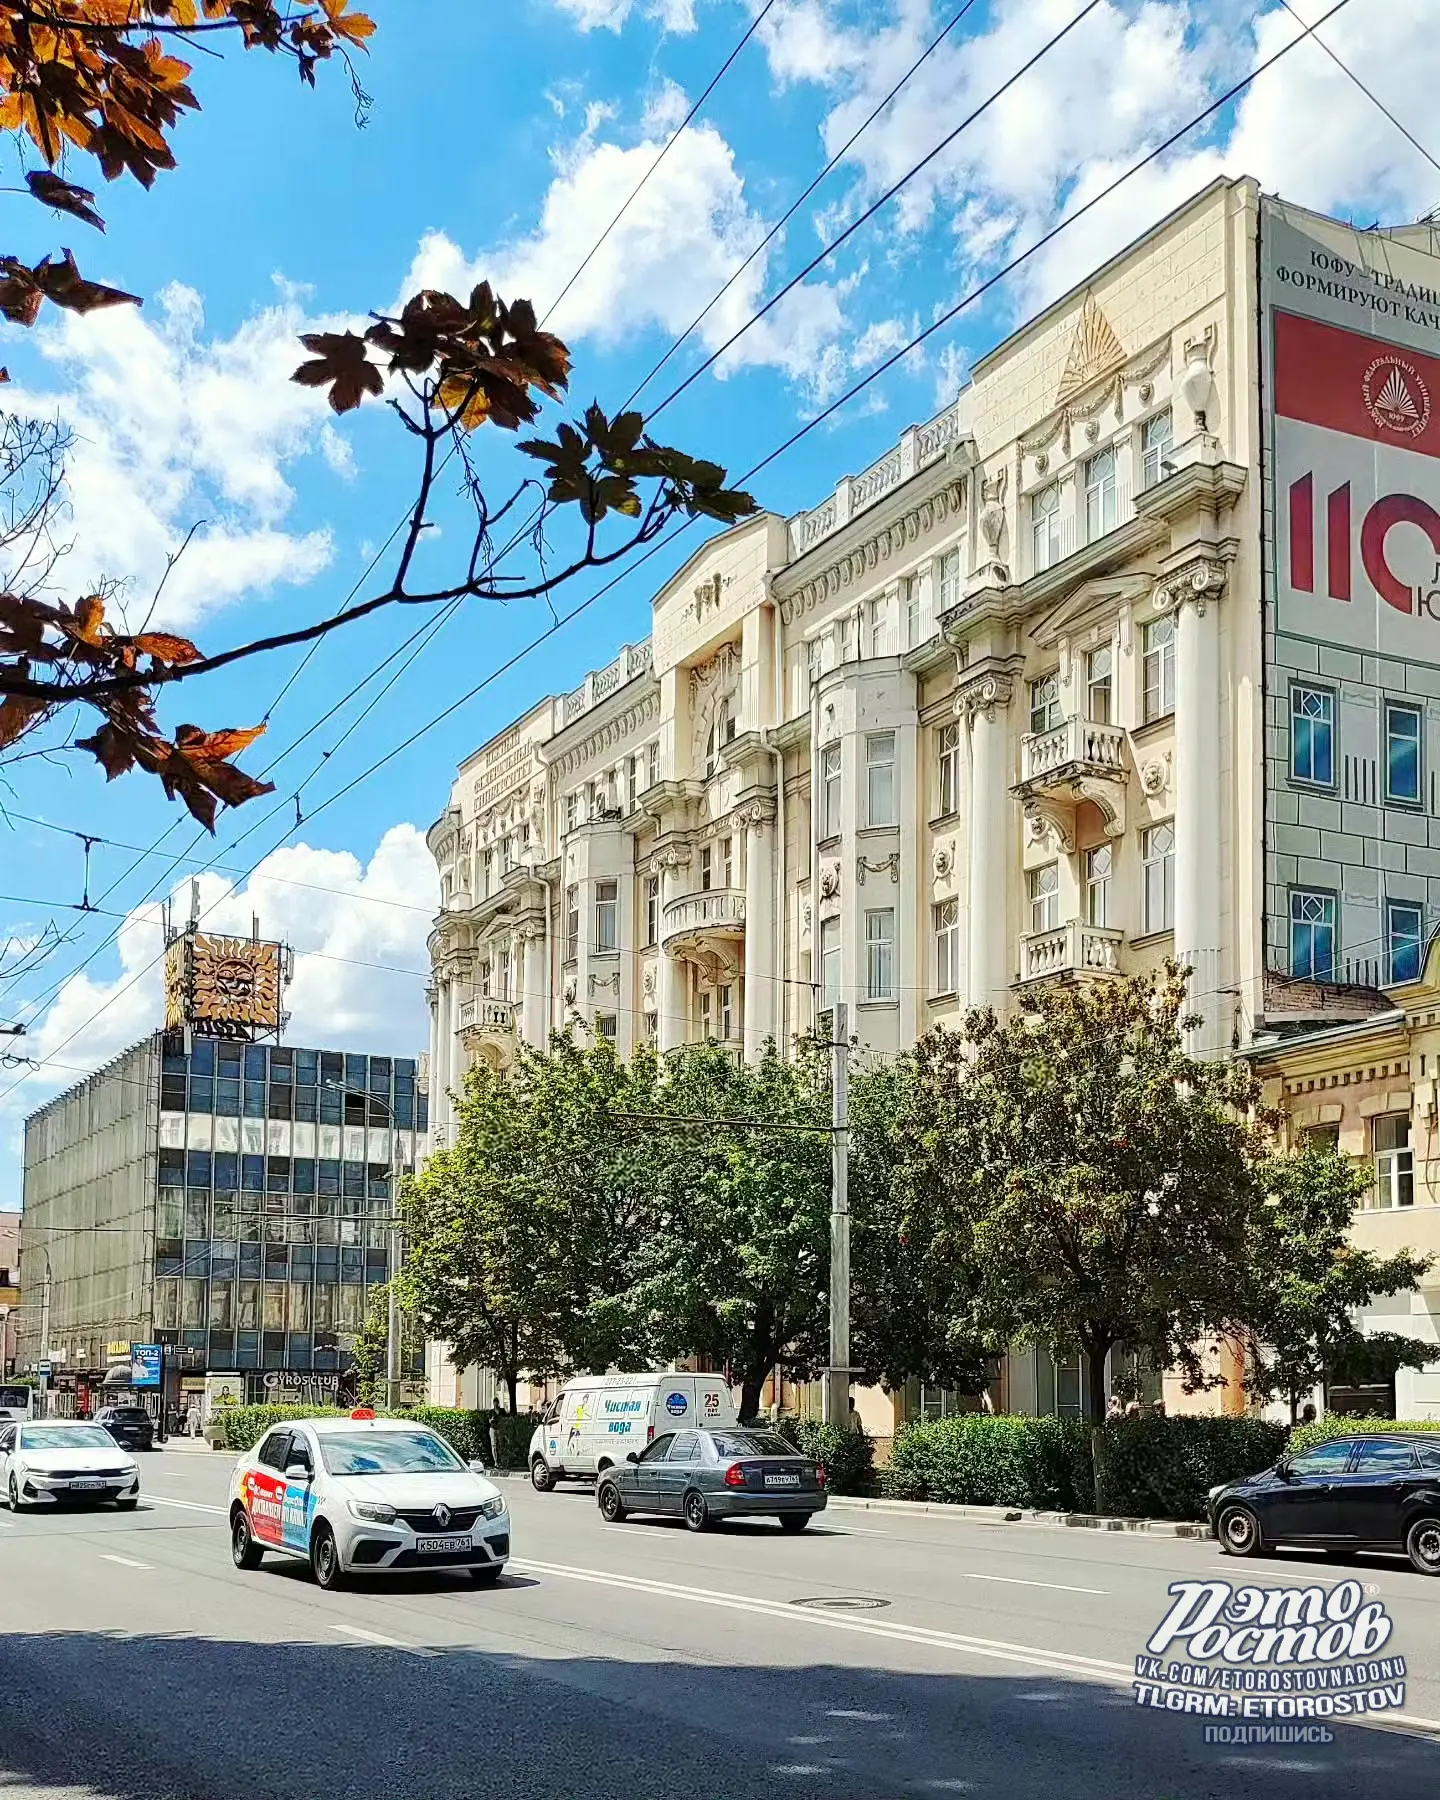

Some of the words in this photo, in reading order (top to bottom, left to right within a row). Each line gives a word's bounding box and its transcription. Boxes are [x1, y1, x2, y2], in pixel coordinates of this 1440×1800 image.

[1310, 250, 1355, 277] ЮФУ
[1276, 265, 1401, 316] ФОРМИРУЮТ
[135, 1349, 159, 1357] ТОП-2
[263, 1371, 309, 1388] GYROS
[604, 1400, 641, 1412] Чистая
[704, 1393, 719, 1408] 25
[608, 1422, 632, 1435] вода
[456, 1539, 470, 1548] 761
